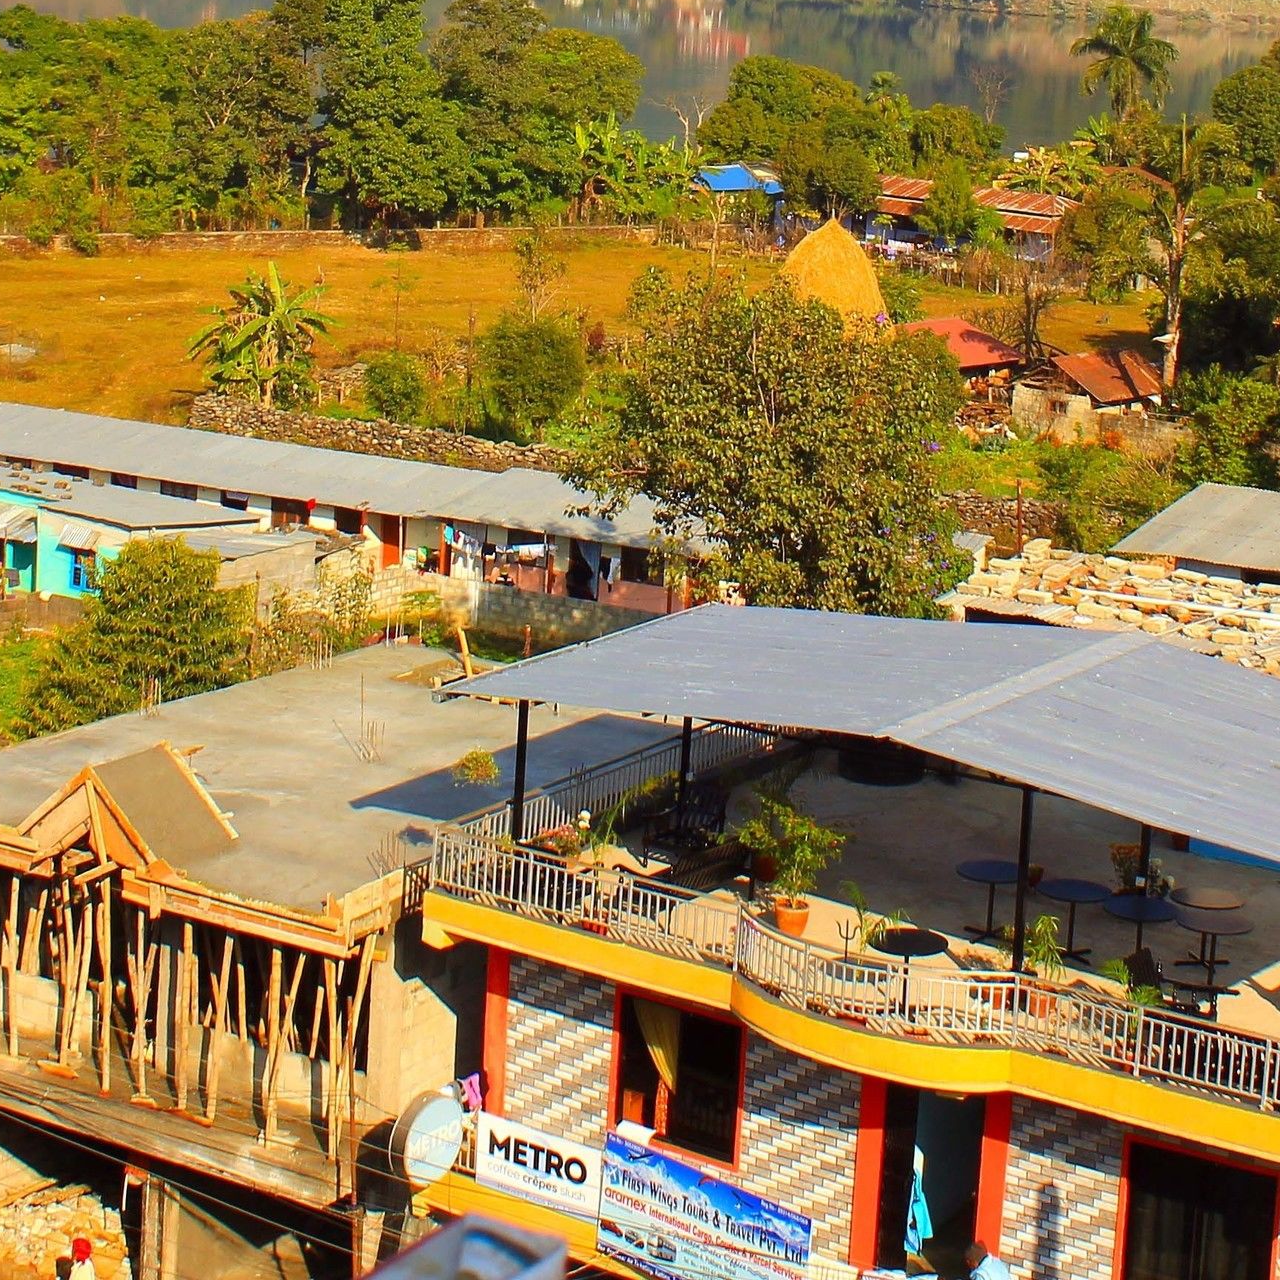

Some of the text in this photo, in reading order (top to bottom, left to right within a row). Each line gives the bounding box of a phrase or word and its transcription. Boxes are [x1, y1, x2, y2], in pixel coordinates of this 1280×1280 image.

[409, 1119, 461, 1159] METRO
[488, 1129, 587, 1185] METRO
[488, 1161, 521, 1180] coffee
[522, 1173, 558, 1193] crêpes
[560, 1186, 586, 1202] slush
[604, 1187, 646, 1214] aramex
[649, 1205, 691, 1233] International
[750, 1252, 771, 1270] Parcel
[713, 1209, 720, 1228] &
